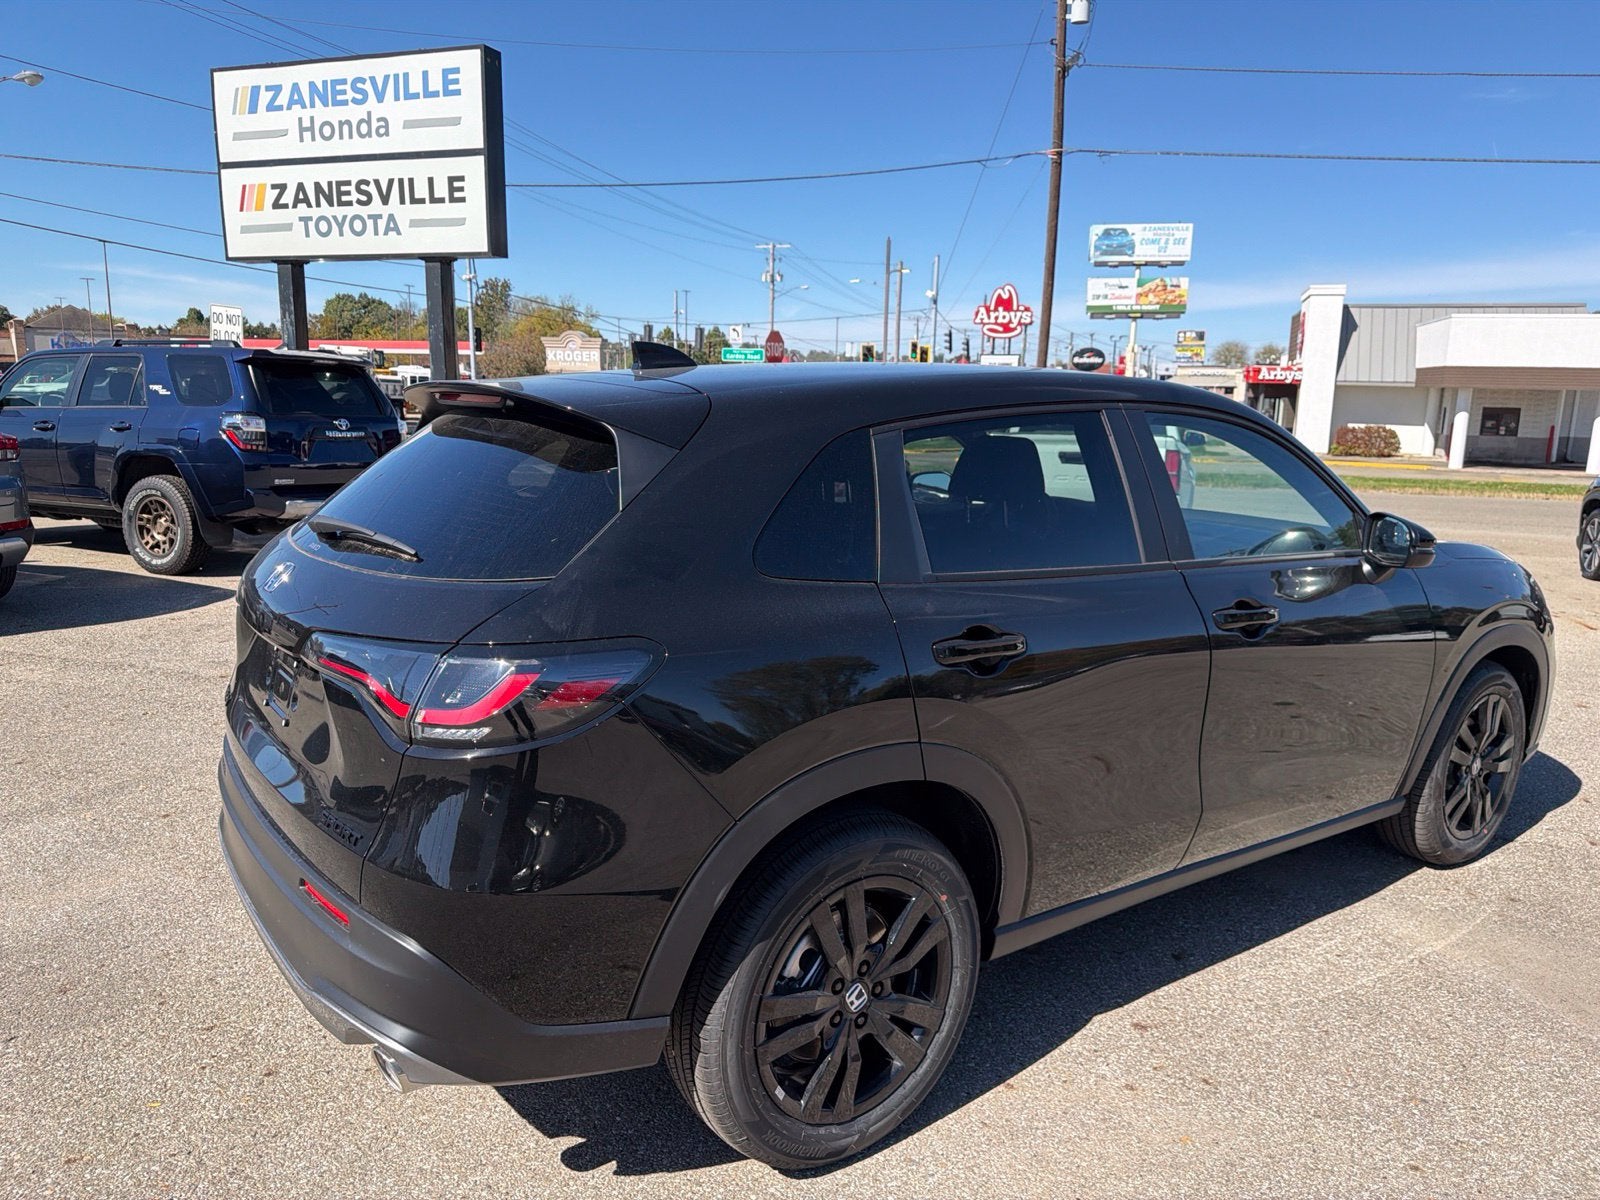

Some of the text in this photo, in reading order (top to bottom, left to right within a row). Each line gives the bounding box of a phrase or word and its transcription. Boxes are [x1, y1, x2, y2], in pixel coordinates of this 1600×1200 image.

[264, 67, 463, 113] ZANESVILLE
[297, 110, 390, 143] Honda
[270, 175, 467, 210] ZANESVILLE
[298, 213, 403, 239] TOYOTA
[1140, 237, 1162, 246] COME
[1172, 237, 1187, 246] SEE
[212, 311, 241, 327] DO NOT
[974, 305, 1032, 328] Arby's
[546, 350, 600, 362] KROGER
[766, 342, 784, 357] STOP
[320, 809, 364, 847] SPORT
